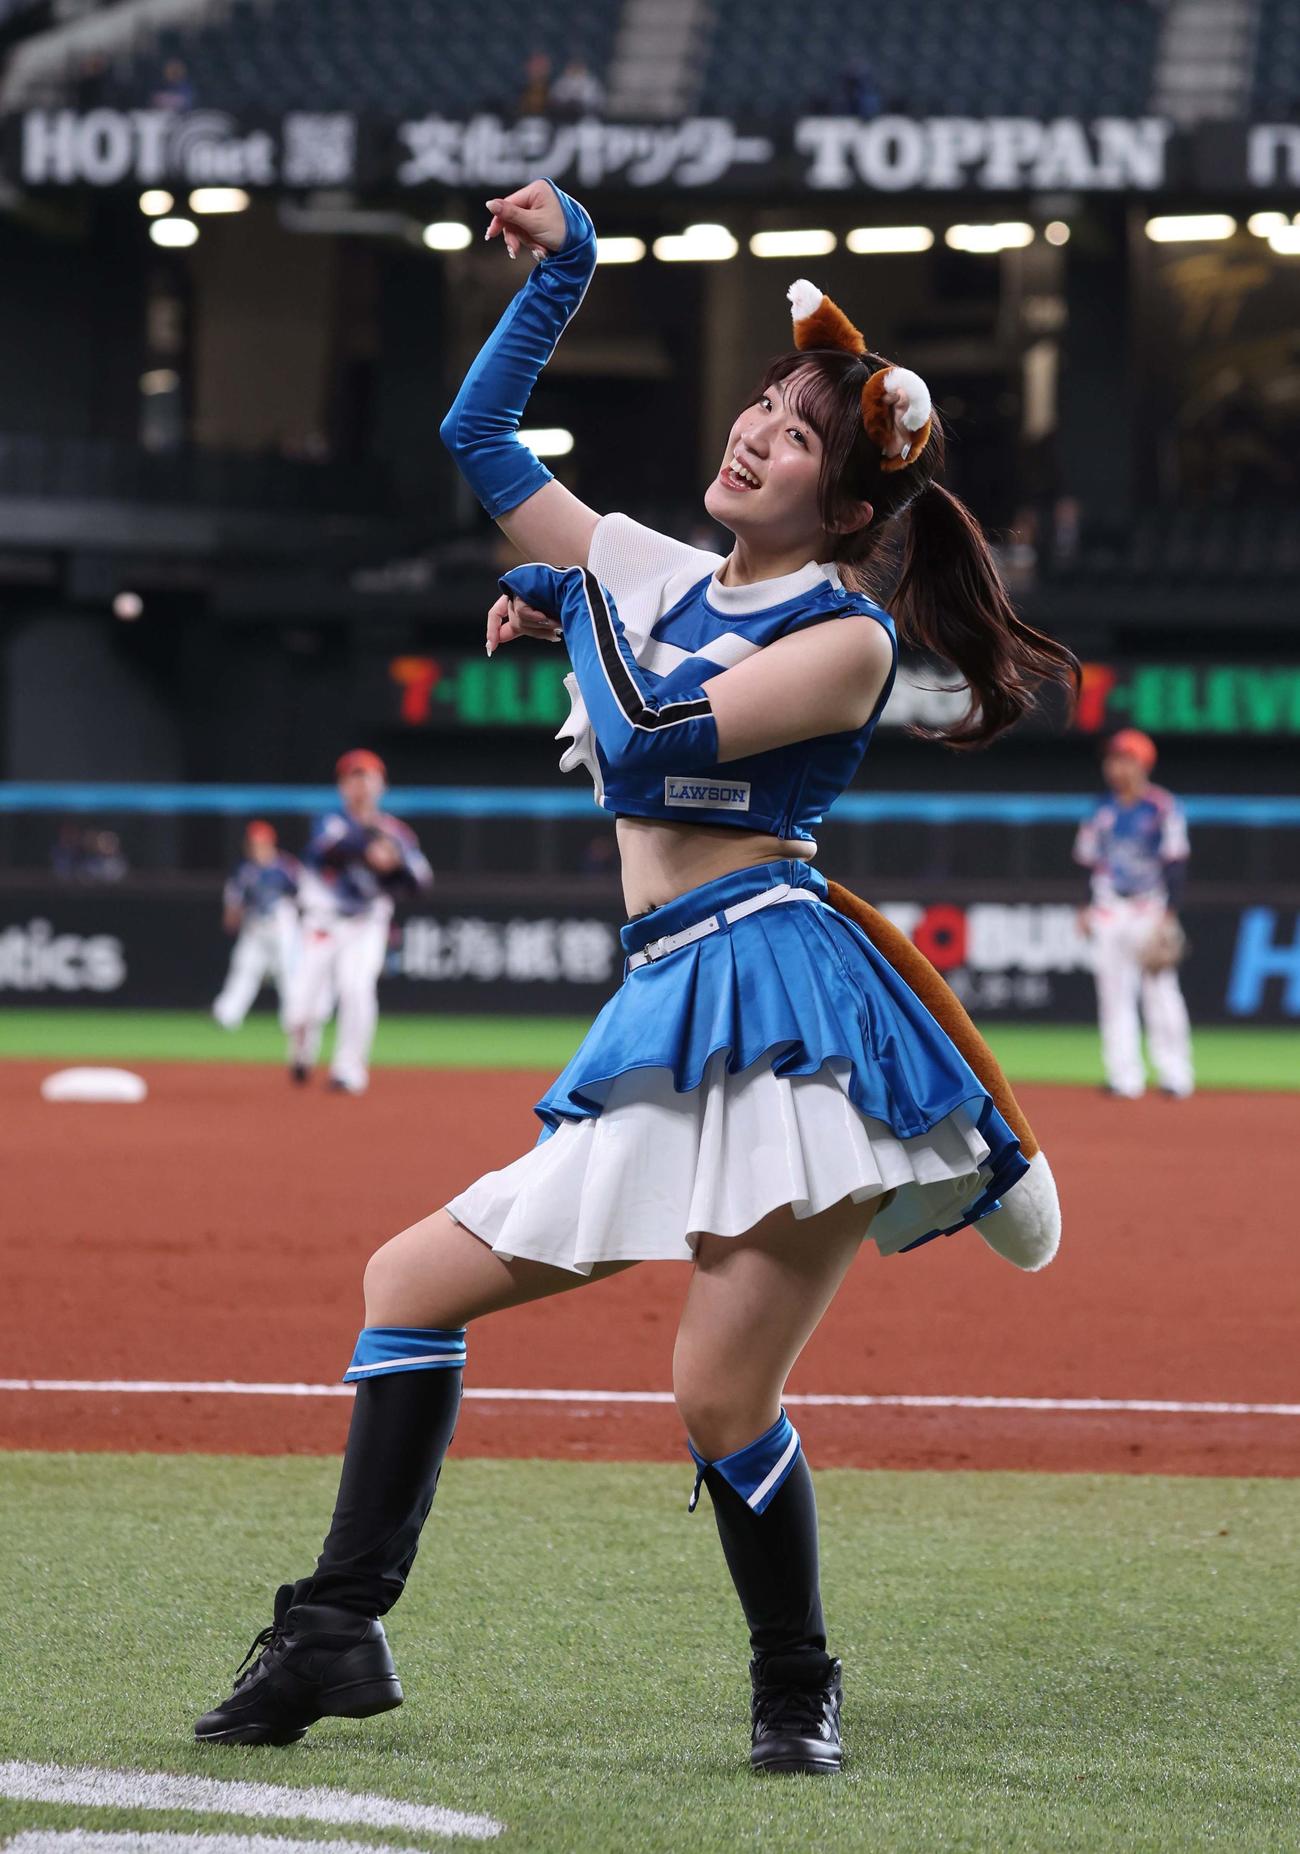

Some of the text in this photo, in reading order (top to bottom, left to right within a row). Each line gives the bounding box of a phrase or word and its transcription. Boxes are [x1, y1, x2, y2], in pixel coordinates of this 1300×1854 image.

[796, 117, 1167, 191] TOPPAN
[669, 785, 746, 802] LAWSON
[0, 918, 126, 991] tics
